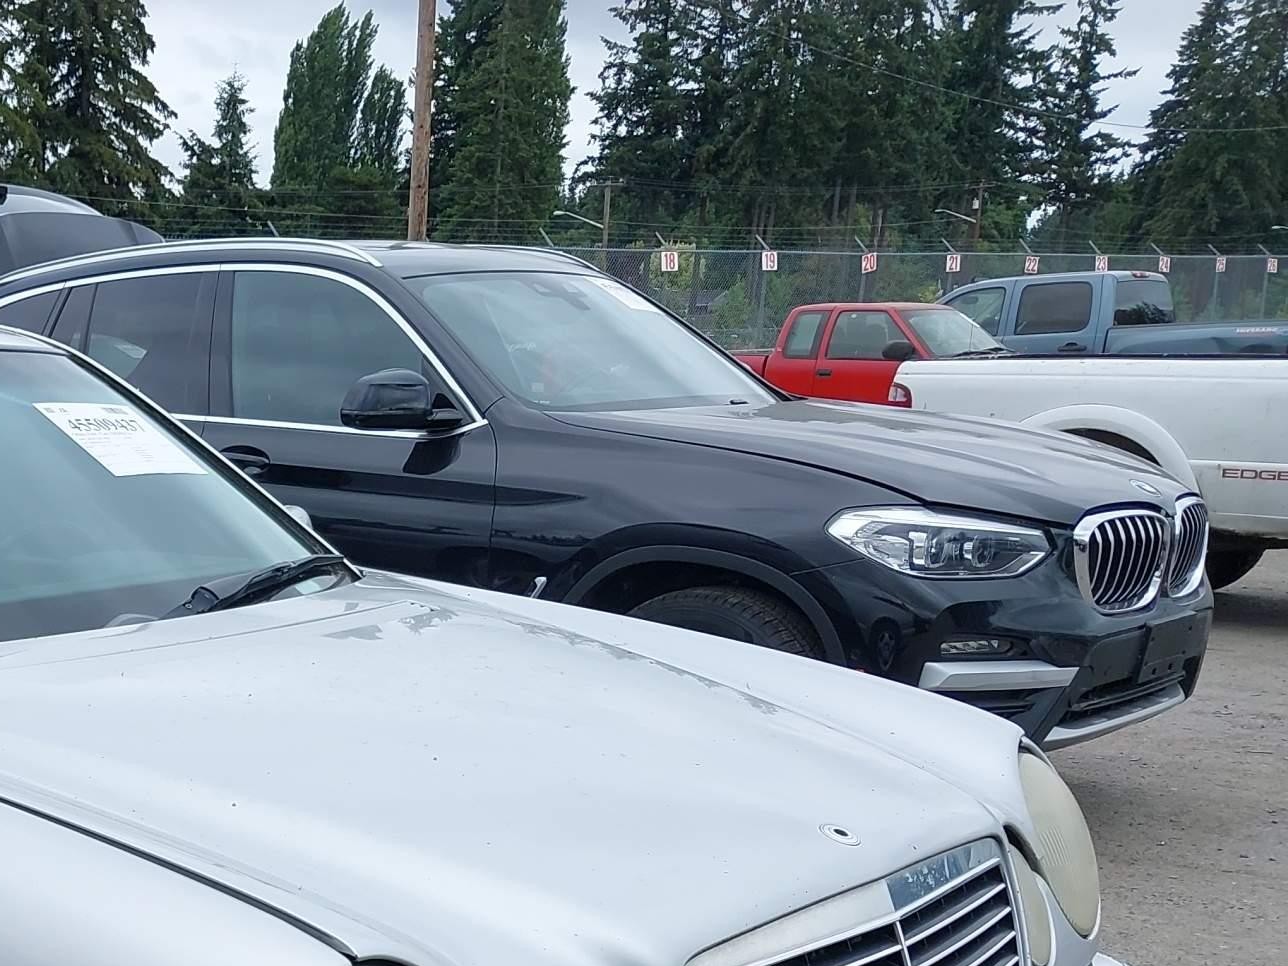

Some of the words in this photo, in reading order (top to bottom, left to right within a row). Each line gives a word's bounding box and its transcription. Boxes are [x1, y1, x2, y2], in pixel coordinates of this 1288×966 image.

[663, 252, 676, 270] 18
[764, 252, 776, 270] 19
[863, 255, 875, 272] 20
[948, 255, 959, 271] 21
[1025, 257, 1037, 272] 22
[1096, 257, 1107, 272] 23
[1159, 257, 1169, 272] 24
[67, 417, 146, 433] 45509437
[1222, 468, 1288, 481] EDGE
